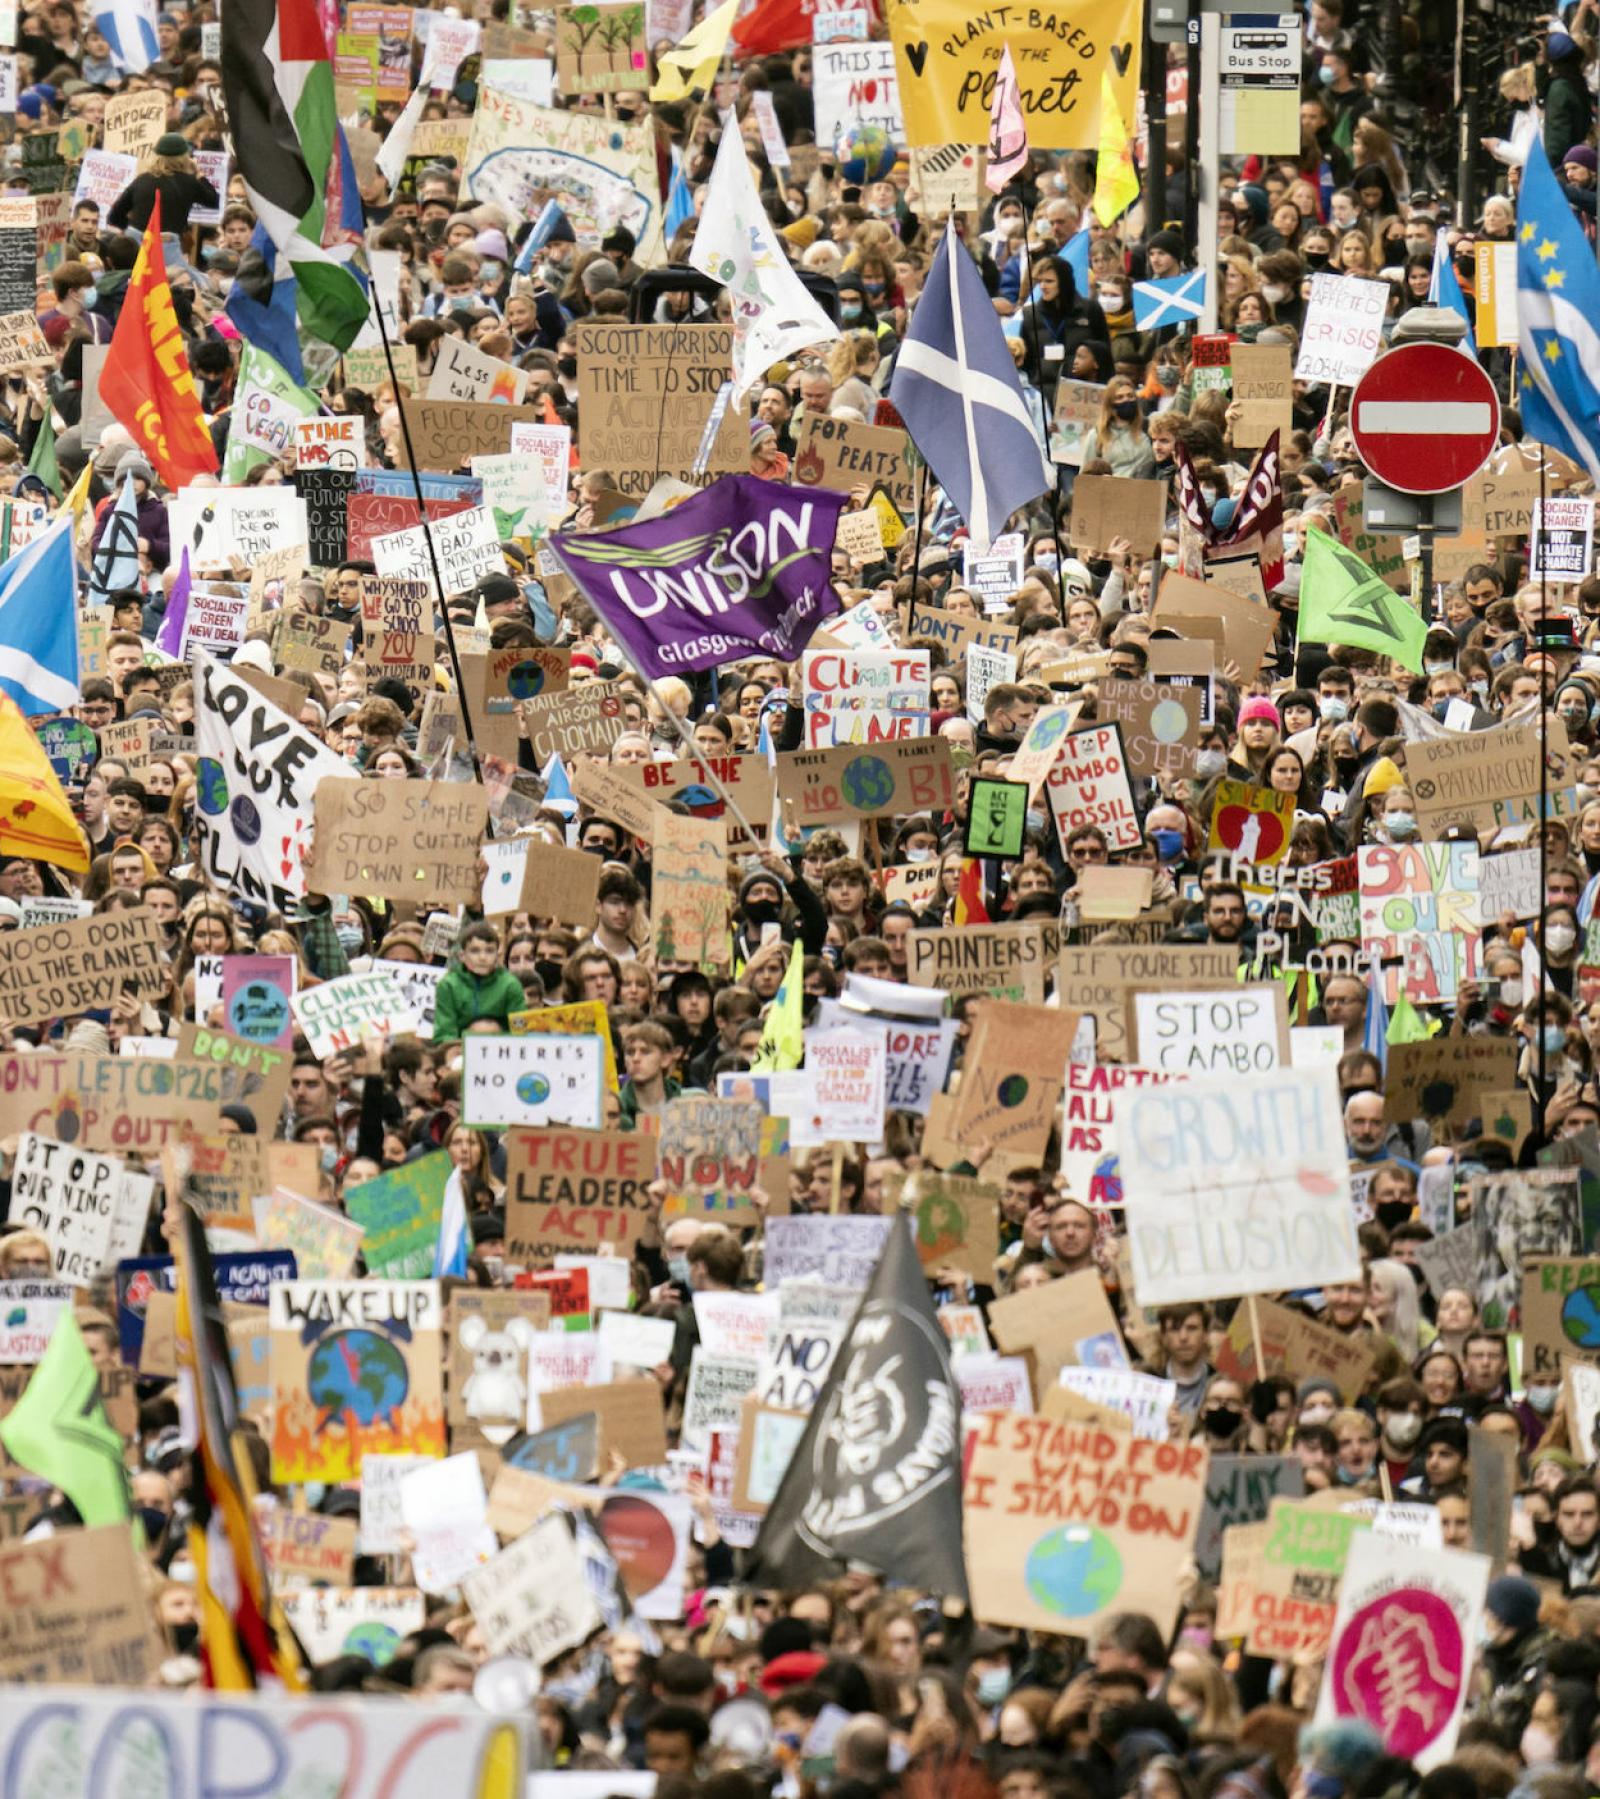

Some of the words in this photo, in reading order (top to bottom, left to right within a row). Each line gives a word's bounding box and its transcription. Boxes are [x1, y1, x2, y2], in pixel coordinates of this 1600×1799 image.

[944, 5, 1096, 61] PLANT-BASED
[824, 50, 867, 73] THIS
[1020, 47, 1050, 63] THE
[1228, 54, 1254, 67] Bus
[1259, 54, 1292, 69] Stop
[849, 78, 893, 104] NOT
[106, 109, 161, 131] EMPOWER
[124, 126, 147, 145] THE
[581, 329, 638, 355] SCOTT
[1306, 325, 1377, 351] CRISIS
[448, 349, 490, 384] Less
[590, 367, 642, 392] TIME
[653, 367, 678, 392] TO
[1236, 381, 1284, 399] CAMBO
[246, 395, 272, 415] GO
[421, 407, 474, 431] FUCK
[810, 417, 848, 442] FOR
[302, 422, 354, 442] TIME
[299, 444, 329, 462] HAS
[837, 444, 900, 472] PEAT'S
[1539, 503, 1588, 516] SOCIALIST
[1540, 516, 1586, 528] CHANGE!
[444, 532, 473, 556] BAD
[1551, 531, 1572, 543] NOT
[609, 502, 814, 619] UNISON
[1538, 546, 1583, 558] CLIMATE
[1538, 559, 1583, 571] CHANGE
[194, 598, 244, 615] SOCIALIST
[211, 612, 242, 626] GREEN
[364, 598, 380, 618] WE
[384, 600, 401, 615] GO
[405, 600, 421, 616] TO
[189, 624, 211, 637] NEW
[213, 626, 241, 640] DEAL
[382, 636, 416, 658] YOU
[1105, 683, 1184, 701] UPROOT
[546, 705, 600, 727] AIRSON
[1104, 703, 1138, 721] THE
[106, 724, 142, 740] THERE
[122, 739, 142, 752] NO
[1427, 736, 1488, 760] DESTROY
[1499, 731, 1525, 747] THE
[643, 763, 675, 786] BE
[698, 758, 742, 784] THE
[1047, 756, 1120, 786] CAMBO
[1439, 755, 1539, 796] PATRIARCHY
[804, 786, 838, 813] NO
[991, 790, 1010, 803] ACT
[1058, 804, 1134, 839] FOSSIL
[336, 832, 400, 855] STOP
[1361, 846, 1478, 896] SAVE
[1383, 892, 1478, 933] OUR
[43, 953, 80, 979] THE
[80, 940, 159, 973] PLANET
[916, 934, 1037, 967] PAINTERS
[1071, 953, 1092, 977] IF
[932, 969, 1011, 989] AGAINST
[40, 986, 71, 1012] SO
[71, 975, 121, 1005] SEXY
[299, 972, 399, 1016] CLIMATE
[306, 1001, 404, 1038] JUSTICE
[1156, 1001, 1260, 1038] STOP
[1159, 1043, 1275, 1074] CAMBO
[524, 1136, 640, 1179] TRUE
[662, 1155, 758, 1191] NOW
[516, 1175, 652, 1212] LEADERS
[282, 1289, 377, 1324] WAKE
[386, 1289, 432, 1324] UP
[775, 1332, 832, 1372] NO
[1011, 1418, 1117, 1462] STAND
[1127, 1435, 1204, 1481] FOR
[1127, 1501, 1190, 1542] ON
